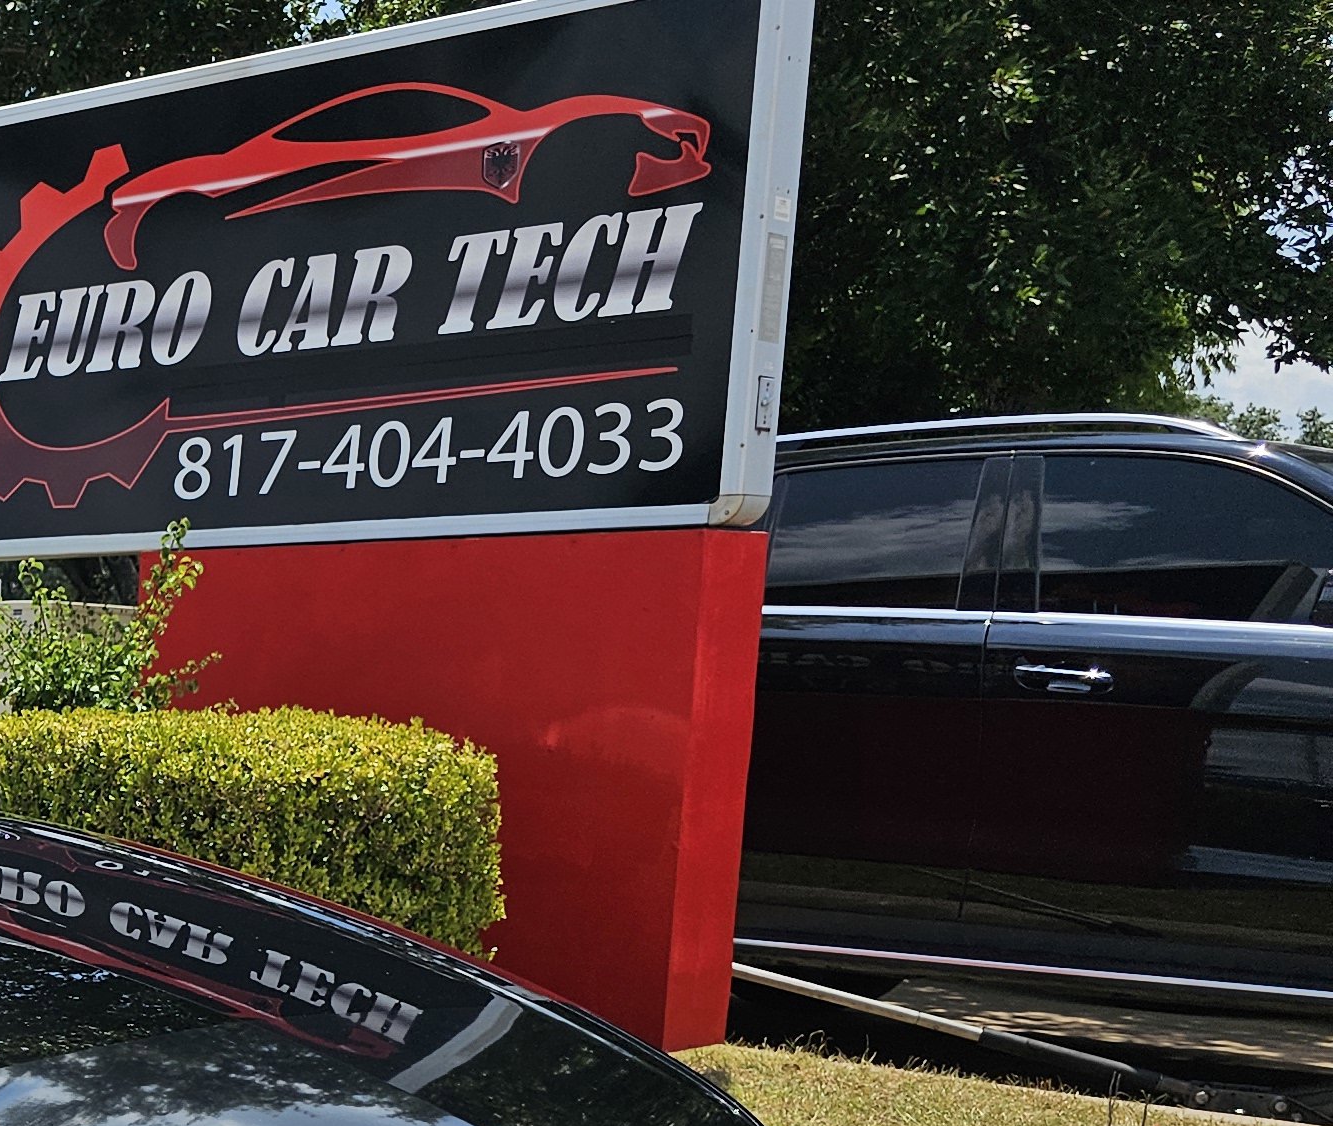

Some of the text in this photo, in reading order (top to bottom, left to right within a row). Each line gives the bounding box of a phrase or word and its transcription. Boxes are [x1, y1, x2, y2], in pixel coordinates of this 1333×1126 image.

[236, 244, 414, 357] CAR
[438, 202, 704, 335] TECH
[172, 398, 685, 500] 817-404-4033
